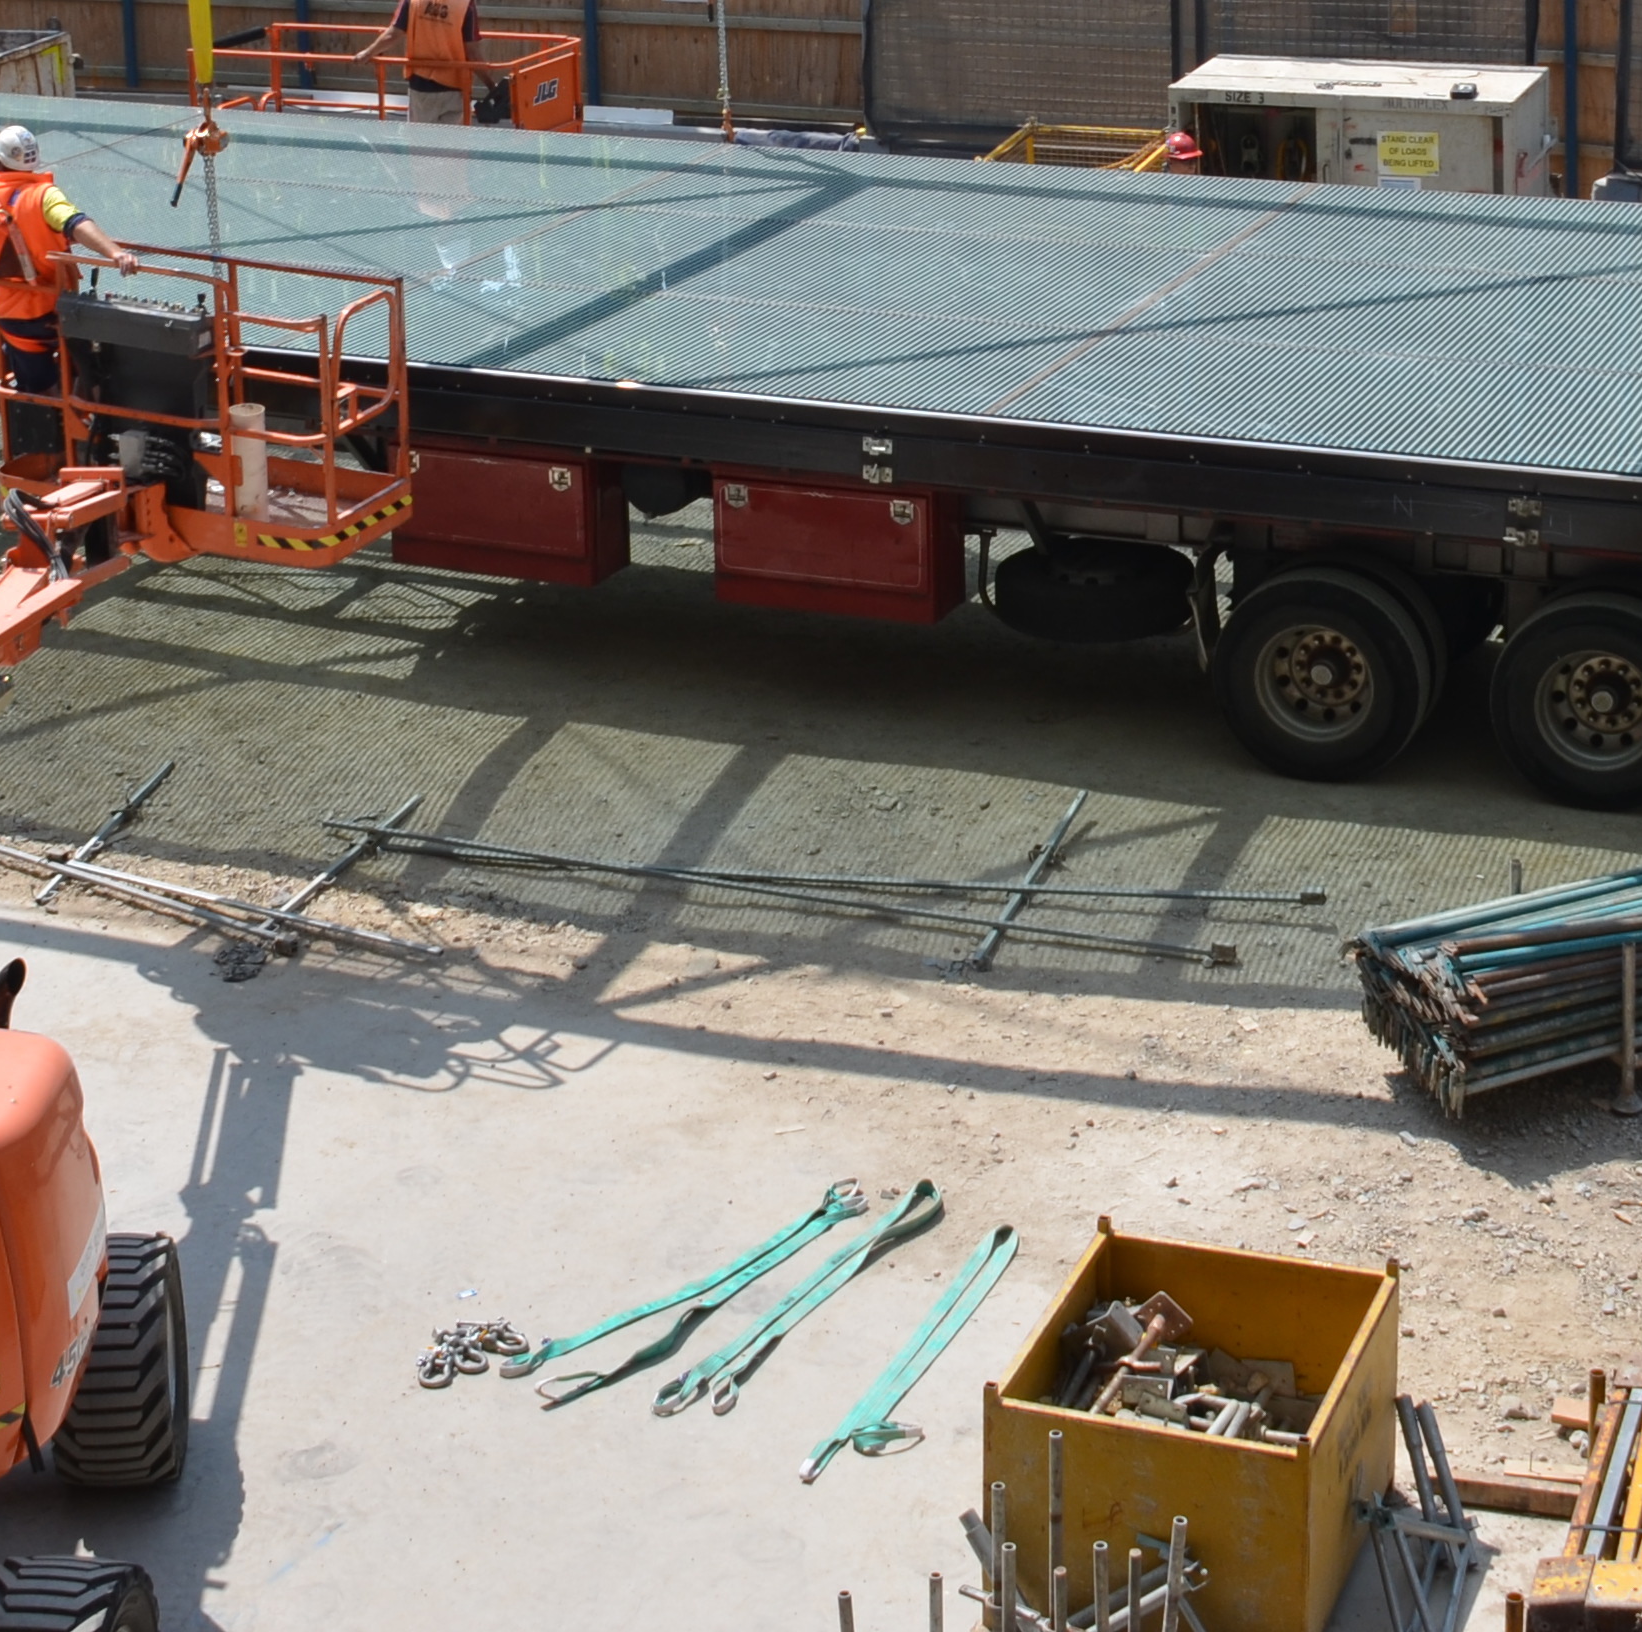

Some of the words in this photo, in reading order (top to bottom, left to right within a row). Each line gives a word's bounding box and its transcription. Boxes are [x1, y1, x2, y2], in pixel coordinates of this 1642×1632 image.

[533, 78, 559, 105] JLG
[1225, 91, 1251, 103] SIZE
[1257, 92, 1265, 104] 3
[1381, 135, 1407, 144] STAND
[1409, 136, 1434, 144] CLEAR
[1388, 147, 1399, 155] OF
[1401, 147, 1427, 156] LOADS
[1383, 158, 1406, 167] BEING
[1408, 159, 1434, 168] LIFTED
